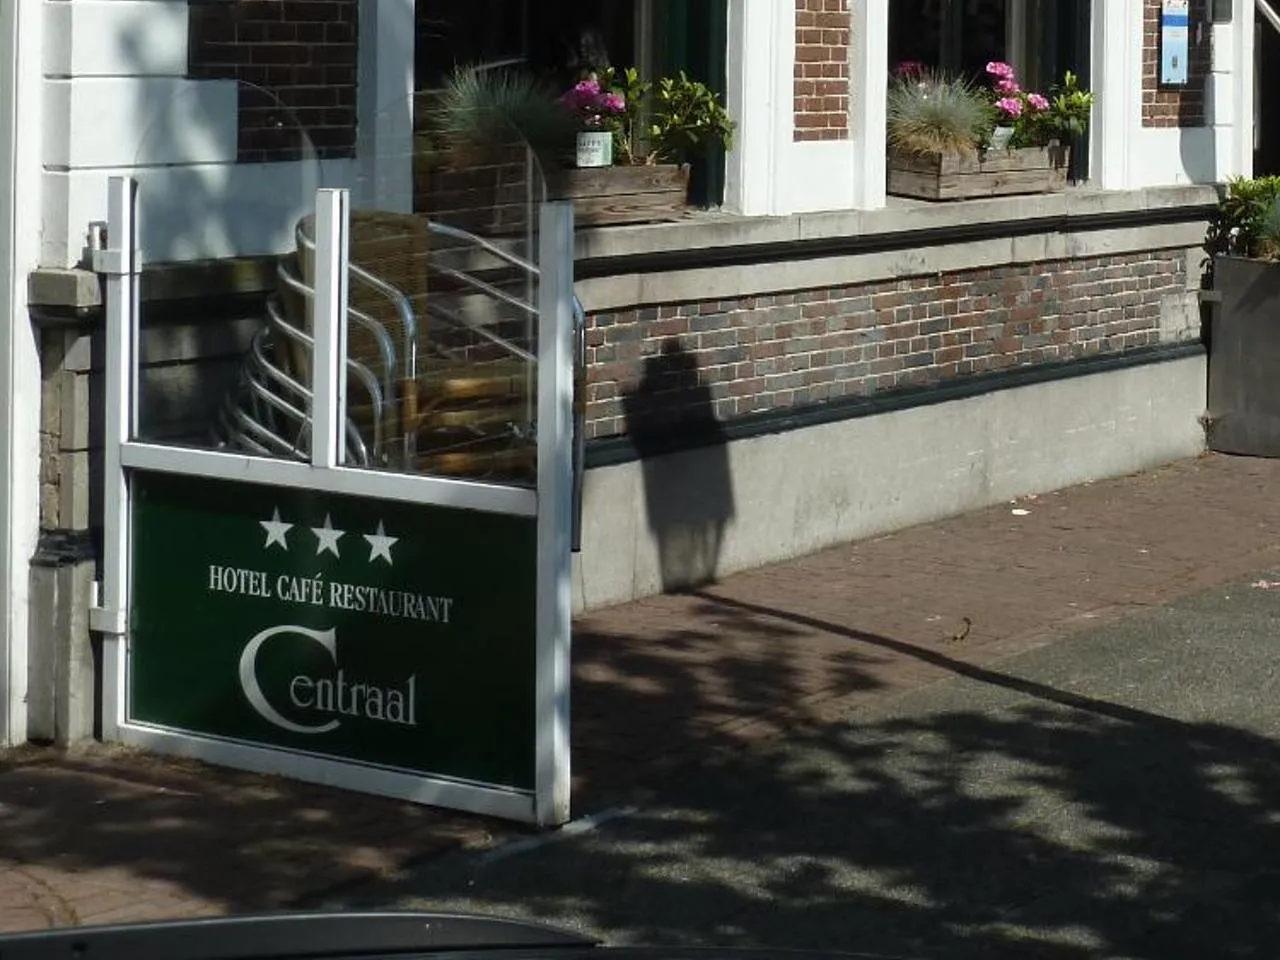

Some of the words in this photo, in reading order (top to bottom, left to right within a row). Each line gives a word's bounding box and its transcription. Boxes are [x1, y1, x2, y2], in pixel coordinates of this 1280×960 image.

[209, 565, 271, 597] HOTEL
[277, 572, 324, 605] CAFÉ
[329, 582, 453, 623] RESTAURANT
[238, 625, 418, 733] Centraal
